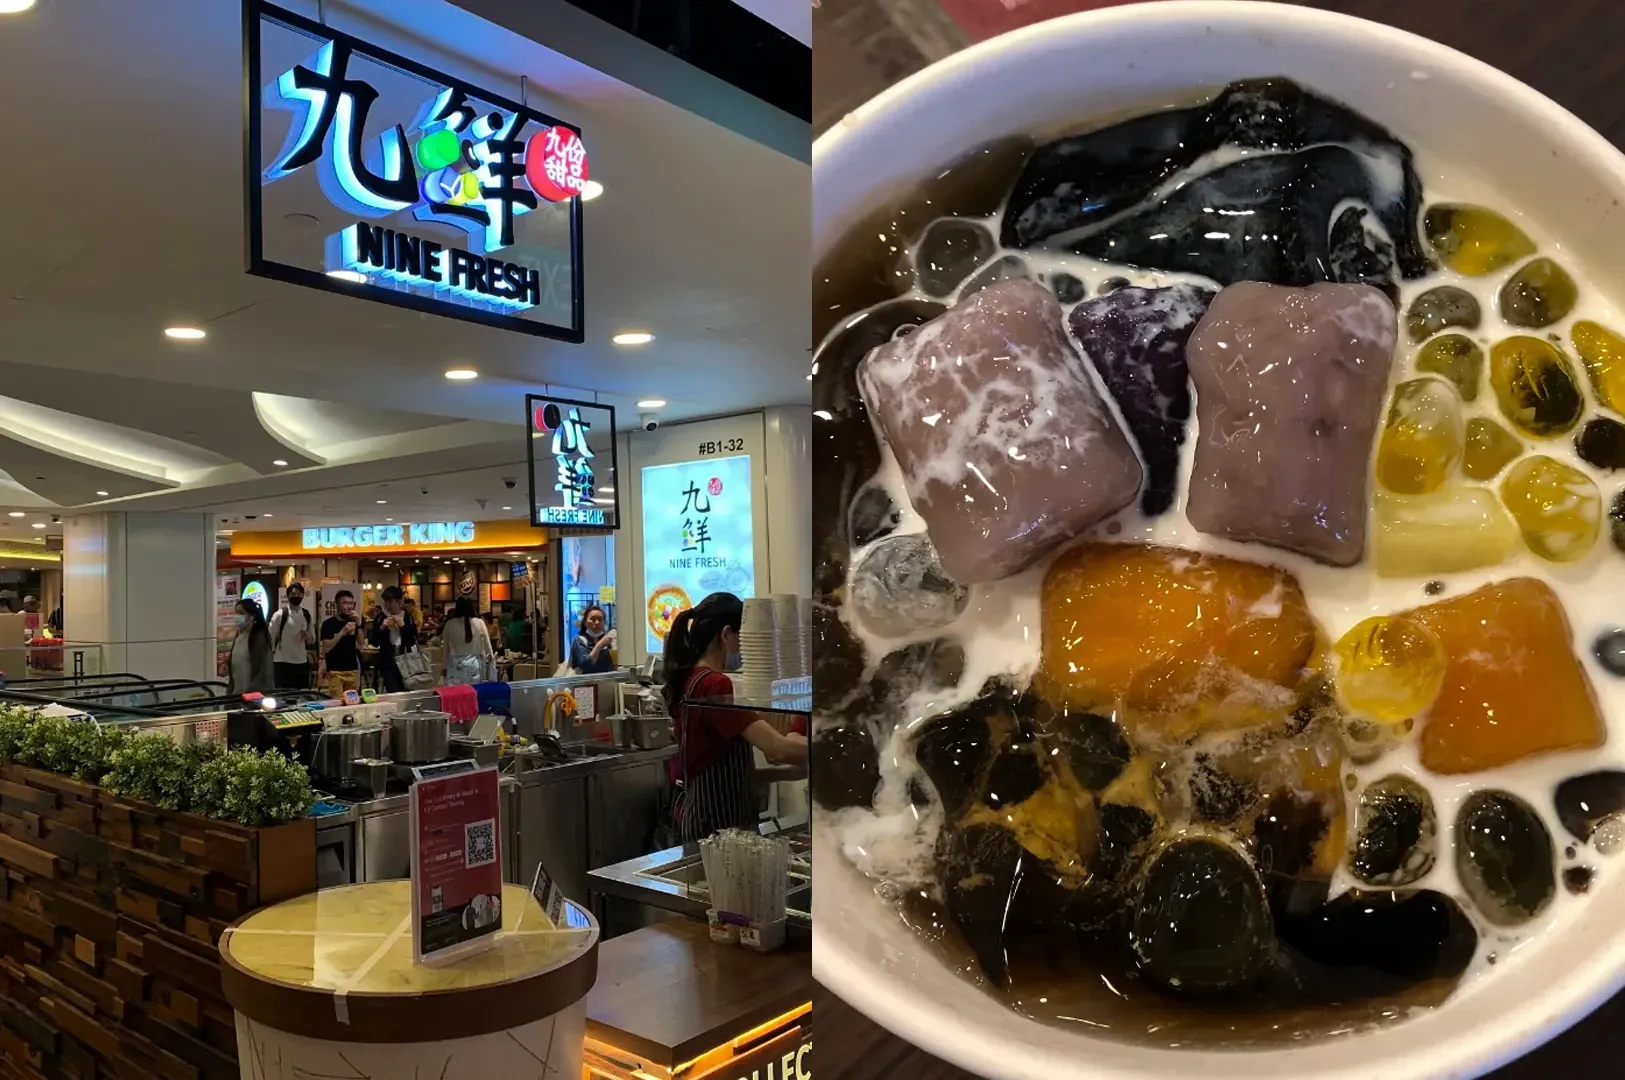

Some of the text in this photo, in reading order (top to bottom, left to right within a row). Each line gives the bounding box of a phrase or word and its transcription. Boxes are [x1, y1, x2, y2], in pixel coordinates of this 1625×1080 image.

[356, 221, 442, 282] NINE
[449, 247, 540, 305] FRESH
[698, 438, 744, 455] #B1-32
[302, 520, 475, 549] BURGER KING
[669, 556, 726, 569] NINE FRESH
